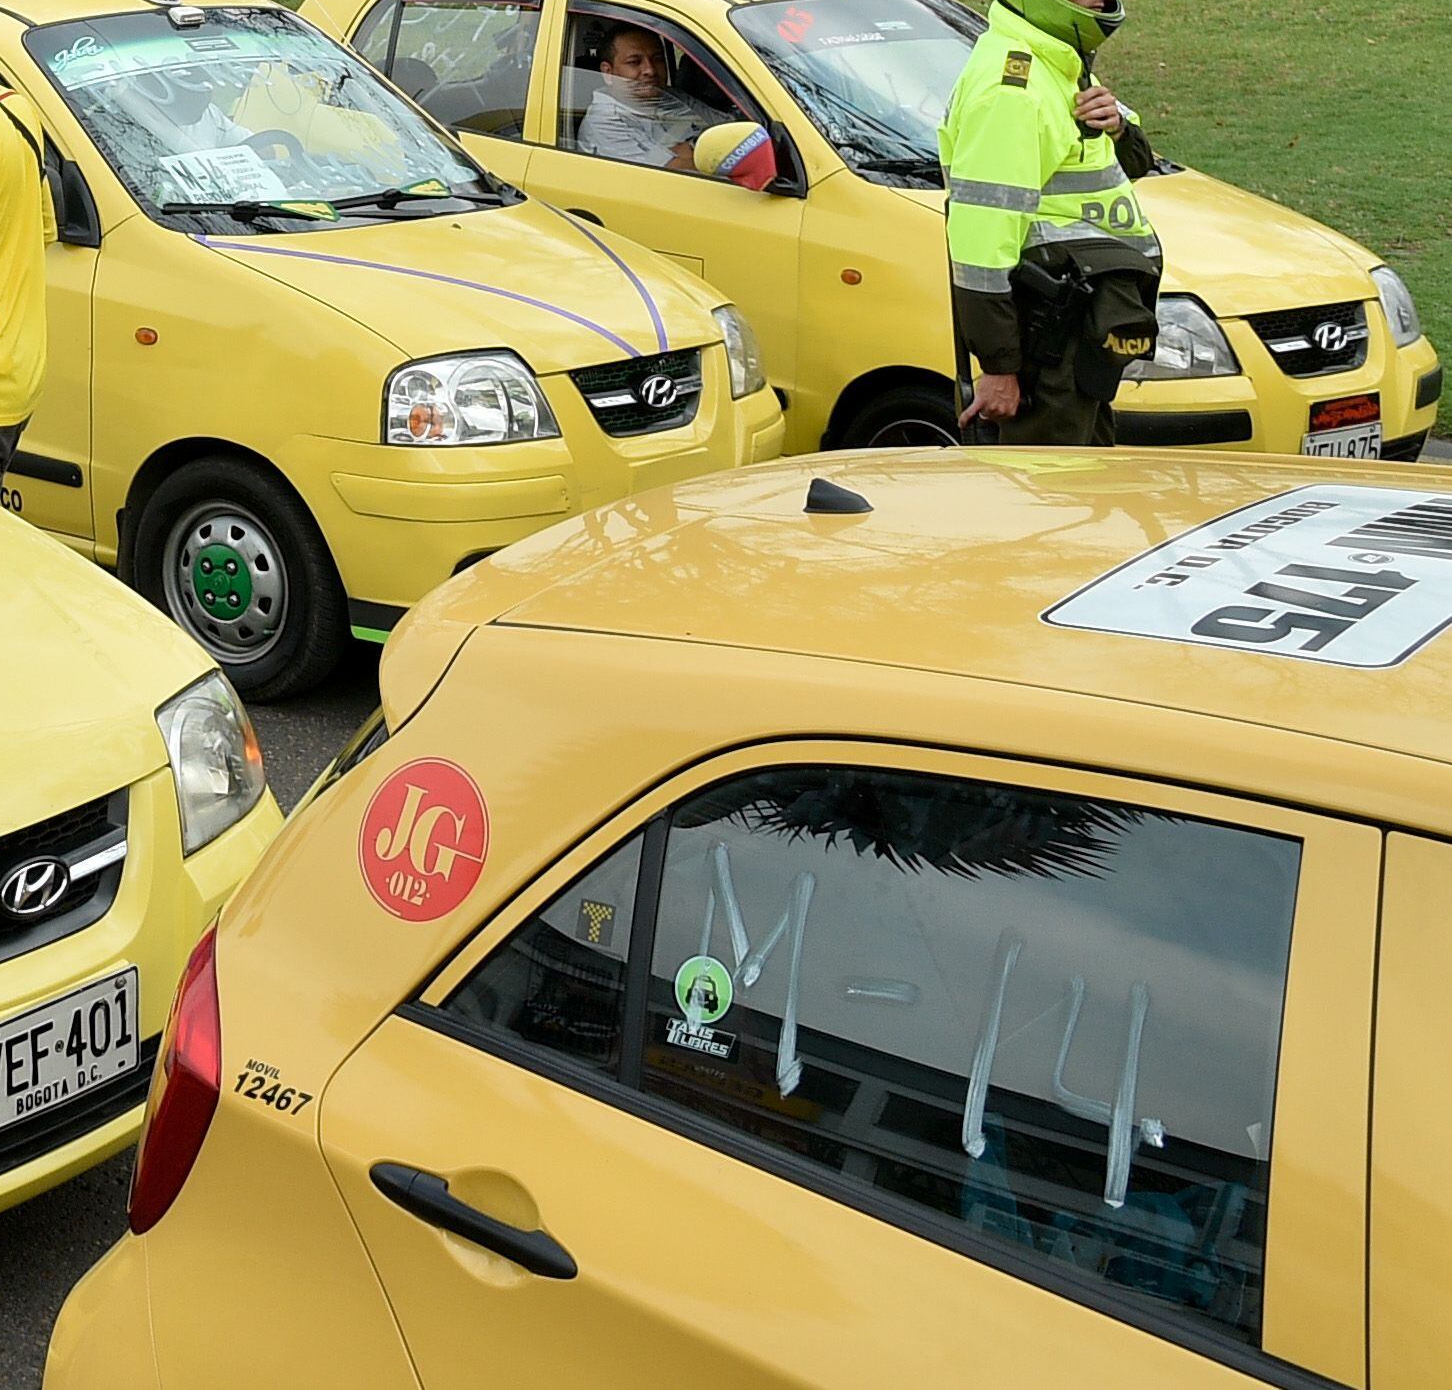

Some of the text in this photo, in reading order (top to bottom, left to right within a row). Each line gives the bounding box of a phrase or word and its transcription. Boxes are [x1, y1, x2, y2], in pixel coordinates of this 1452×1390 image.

[722, 128, 768, 171] COLOMBIA
[1132, 500, 1341, 591] BOGOTA D.C.
[1190, 563, 1421, 653] 175
[375, 782, 485, 883] JG
[65, 988, 132, 1068] 401
[679, 1031, 731, 1058] LIBRES
[16, 1064, 103, 1116] BOGOTA D.C.
[232, 1071, 313, 1116] 12467
[244, 1058, 281, 1081] MOVIL
